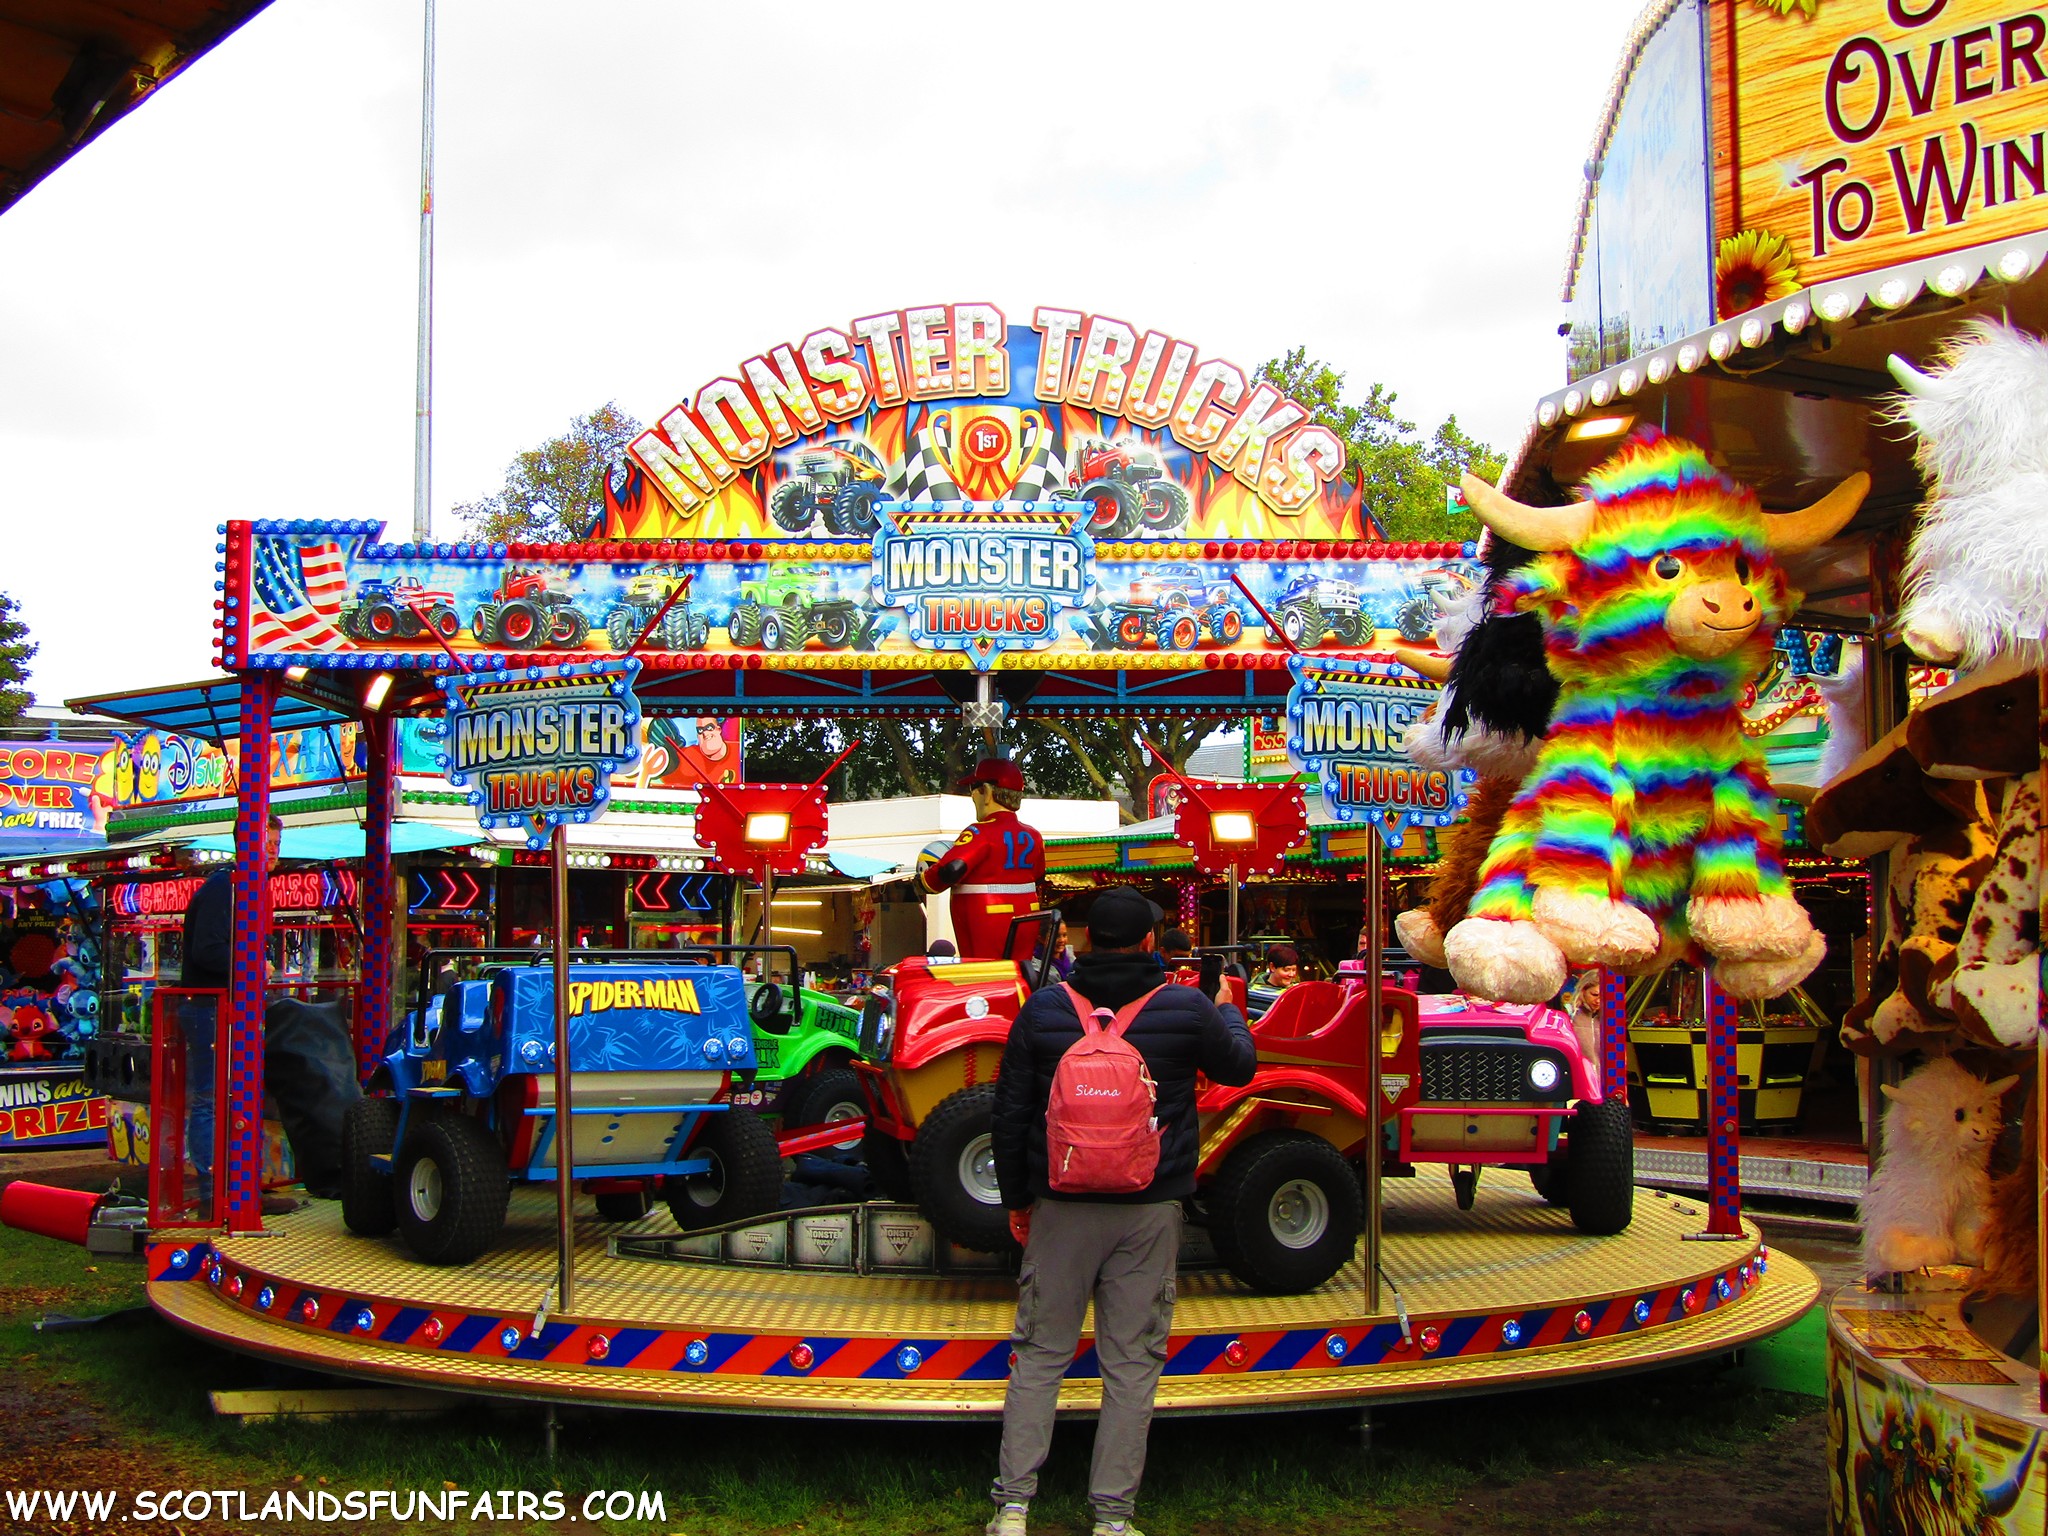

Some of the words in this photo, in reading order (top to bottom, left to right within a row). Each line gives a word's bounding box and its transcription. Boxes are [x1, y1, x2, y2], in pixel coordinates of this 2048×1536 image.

[1824, 13, 2048, 144] OVER
[1887, 121, 2048, 235] WIN
[630, 303, 1006, 518] MONSTER
[1034, 306, 1347, 516] TRUCKS
[976, 431, 998, 452] 1ST
[889, 537, 1080, 591] MONSTER
[923, 596, 1046, 633] TRUCKS
[457, 703, 627, 769] MONSTER
[1303, 700, 1427, 753] MONS
[272, 728, 337, 777] XAR
[487, 766, 595, 810] TRUCKS
[1336, 764, 1448, 807] TRUCKS
[4, 811, 38, 828] any
[38, 811, 83, 829] PRIZE
[1003, 831, 1034, 870] 12
[270, 873, 319, 908] MES
[569, 979, 702, 1016] SPIDER-MAN
[1075, 1084, 1121, 1097] Sienna
[807, 1230, 843, 1239] MONSTER
